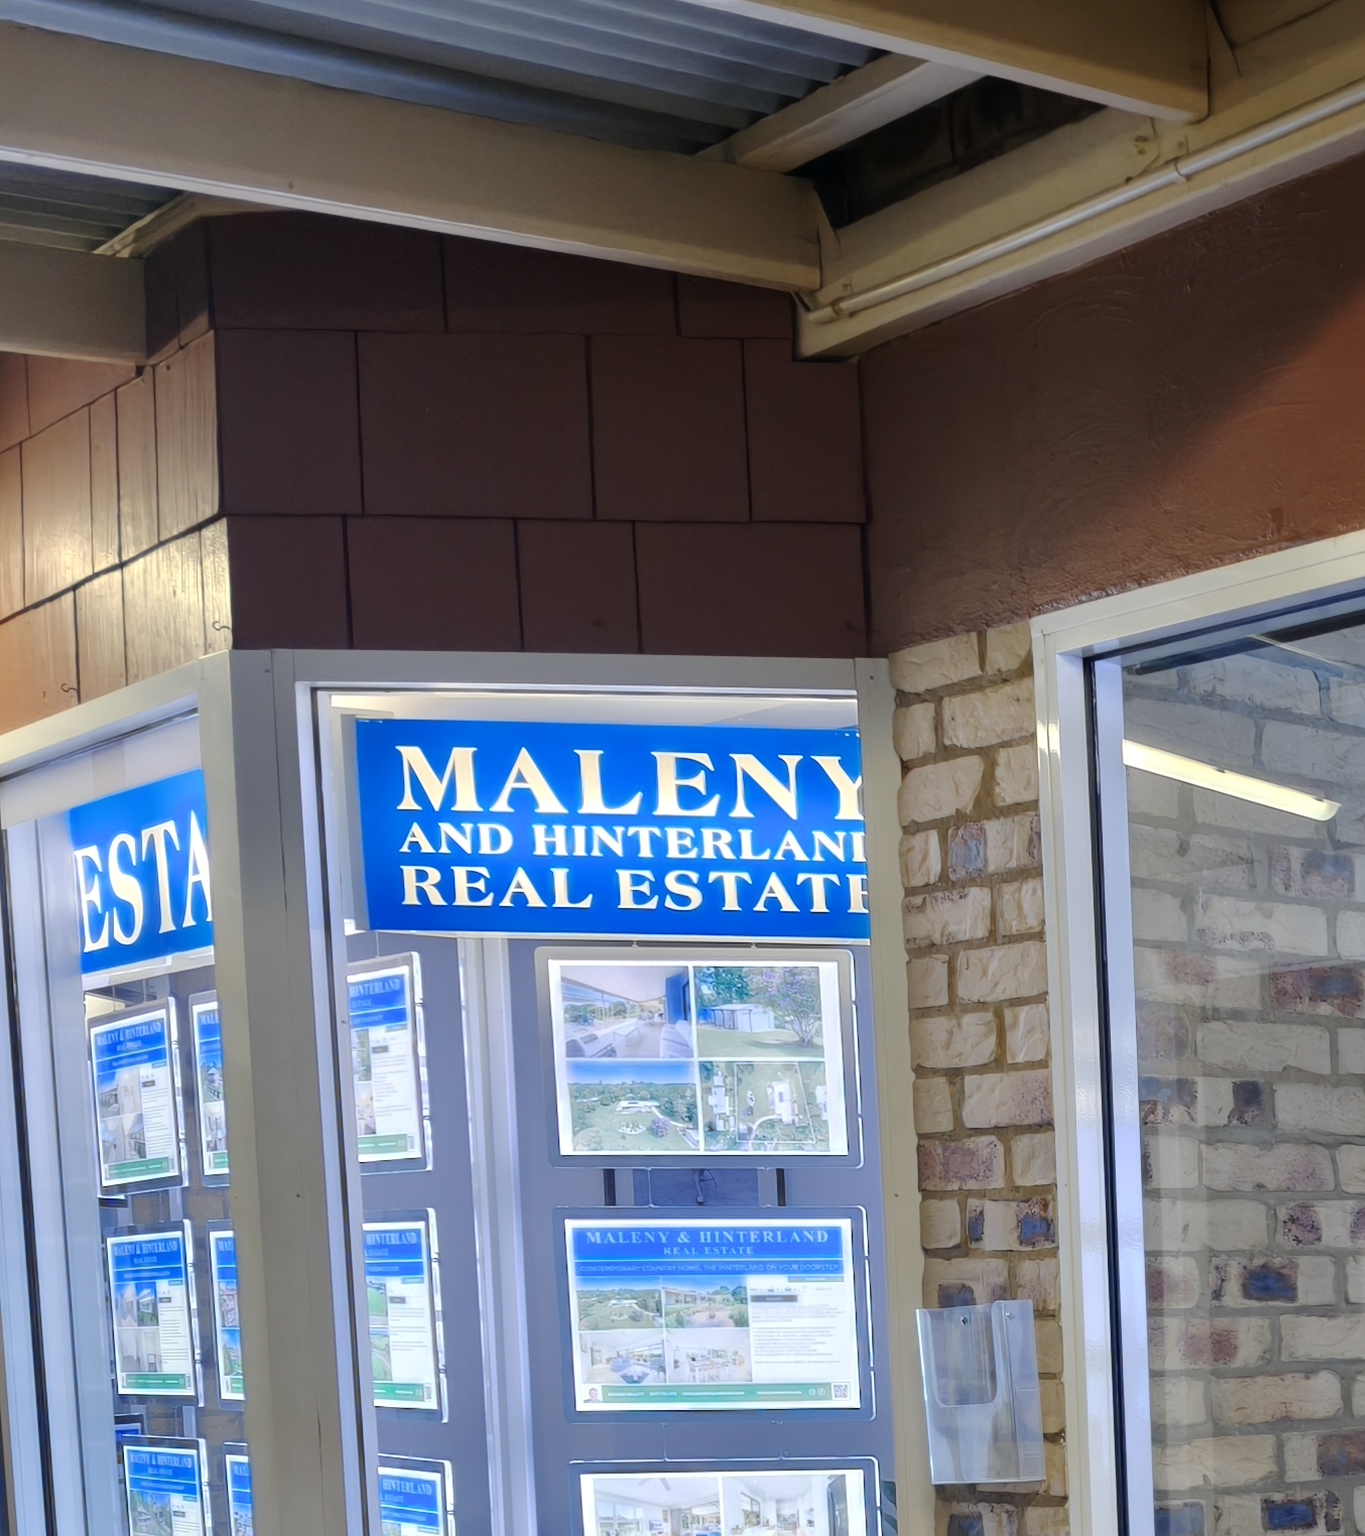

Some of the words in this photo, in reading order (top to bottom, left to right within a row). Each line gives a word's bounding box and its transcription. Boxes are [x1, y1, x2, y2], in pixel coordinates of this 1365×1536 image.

[395, 745, 863, 821] MALENY
[399, 821, 513, 855] AND
[74, 810, 213, 953] ESTA
[400, 865, 593, 908] REAL
[586, 1231, 671, 1244] MALENY
[677, 1231, 691, 1243] &
[700, 1230, 829, 1244] HINTERLAND
[663, 1246, 699, 1255] REAL
[704, 1245, 755, 1255] ESTATE
